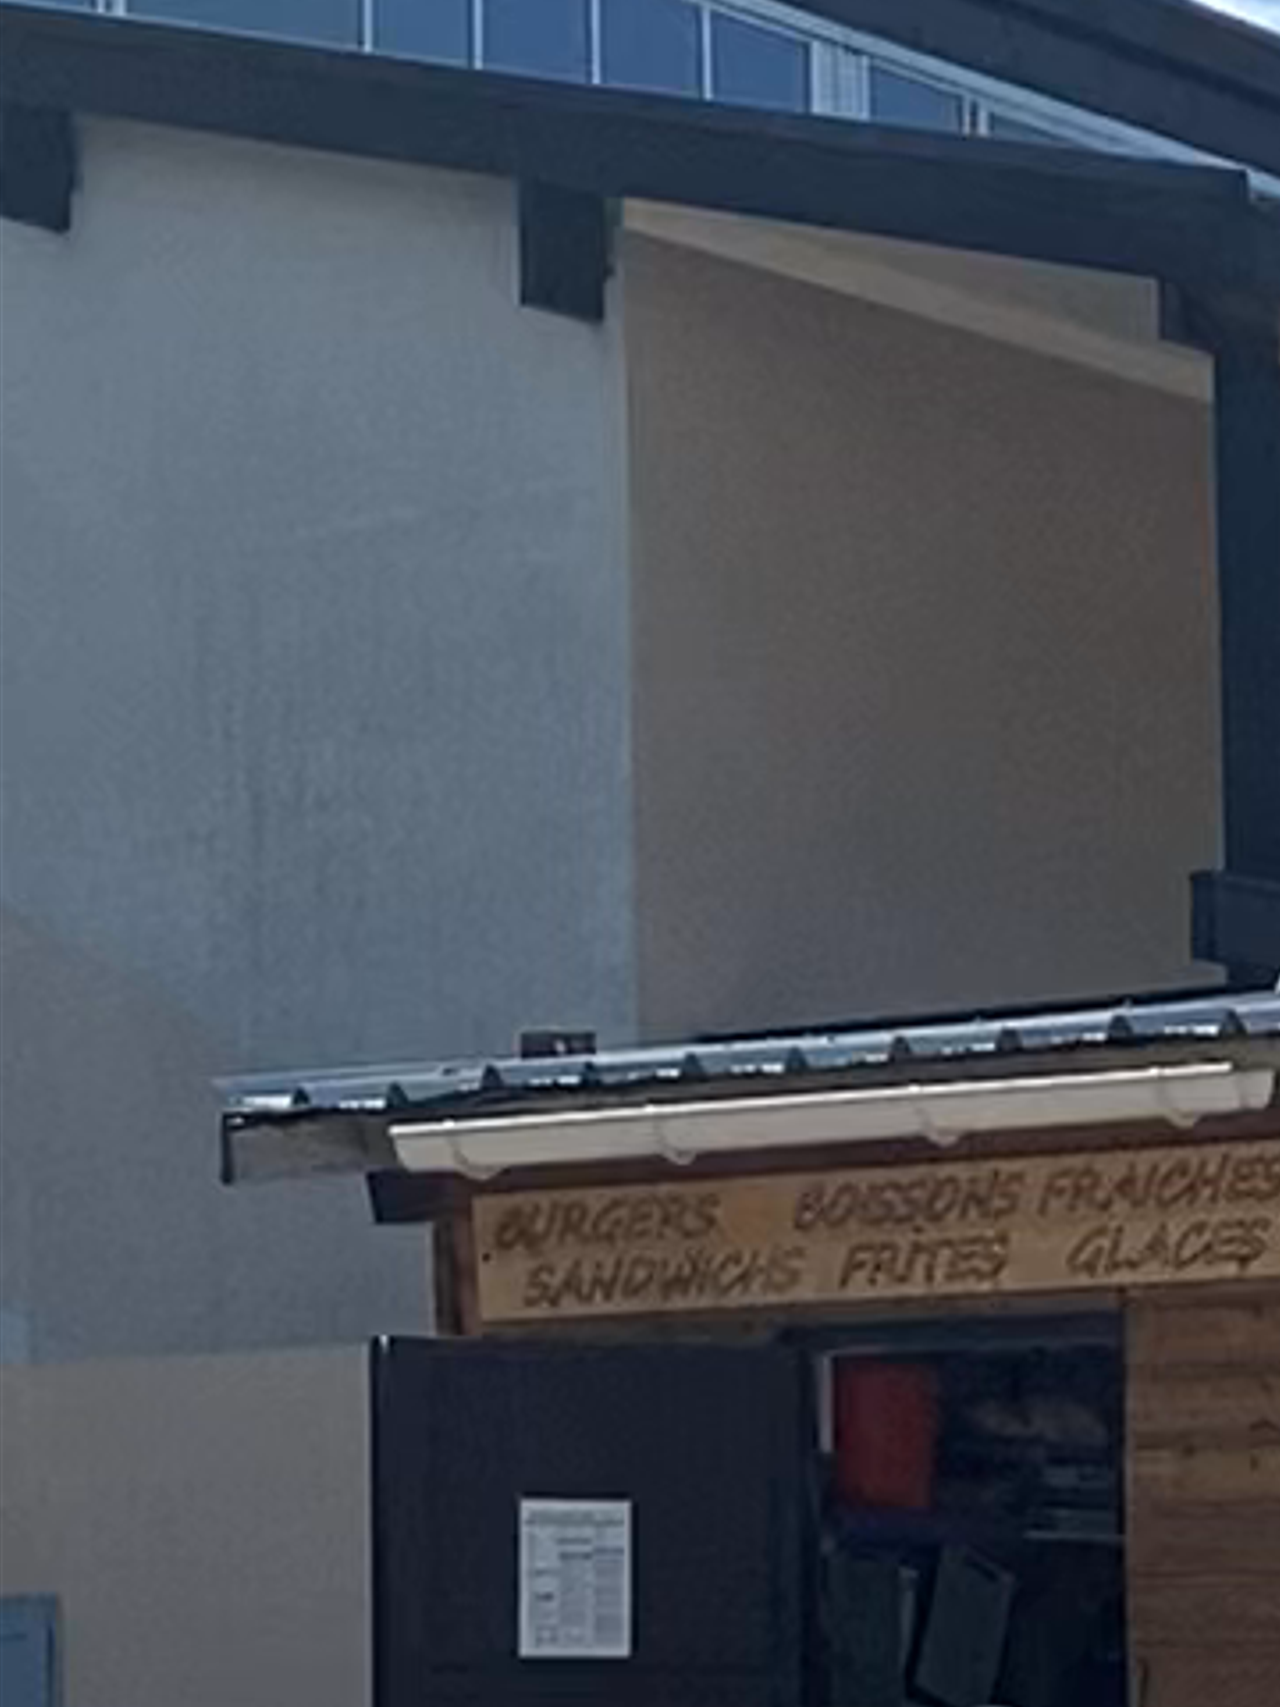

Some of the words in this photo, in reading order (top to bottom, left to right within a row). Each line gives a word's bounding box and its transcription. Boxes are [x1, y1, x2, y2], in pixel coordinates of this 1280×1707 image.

[494, 1193, 720, 1252] BURGERS
[793, 1169, 1025, 1232] BOISSONS
[523, 1244, 806, 1309] SANDWICHS
[839, 1225, 1009, 1289] FRITES
[1065, 1216, 1271, 1279] GLACES
